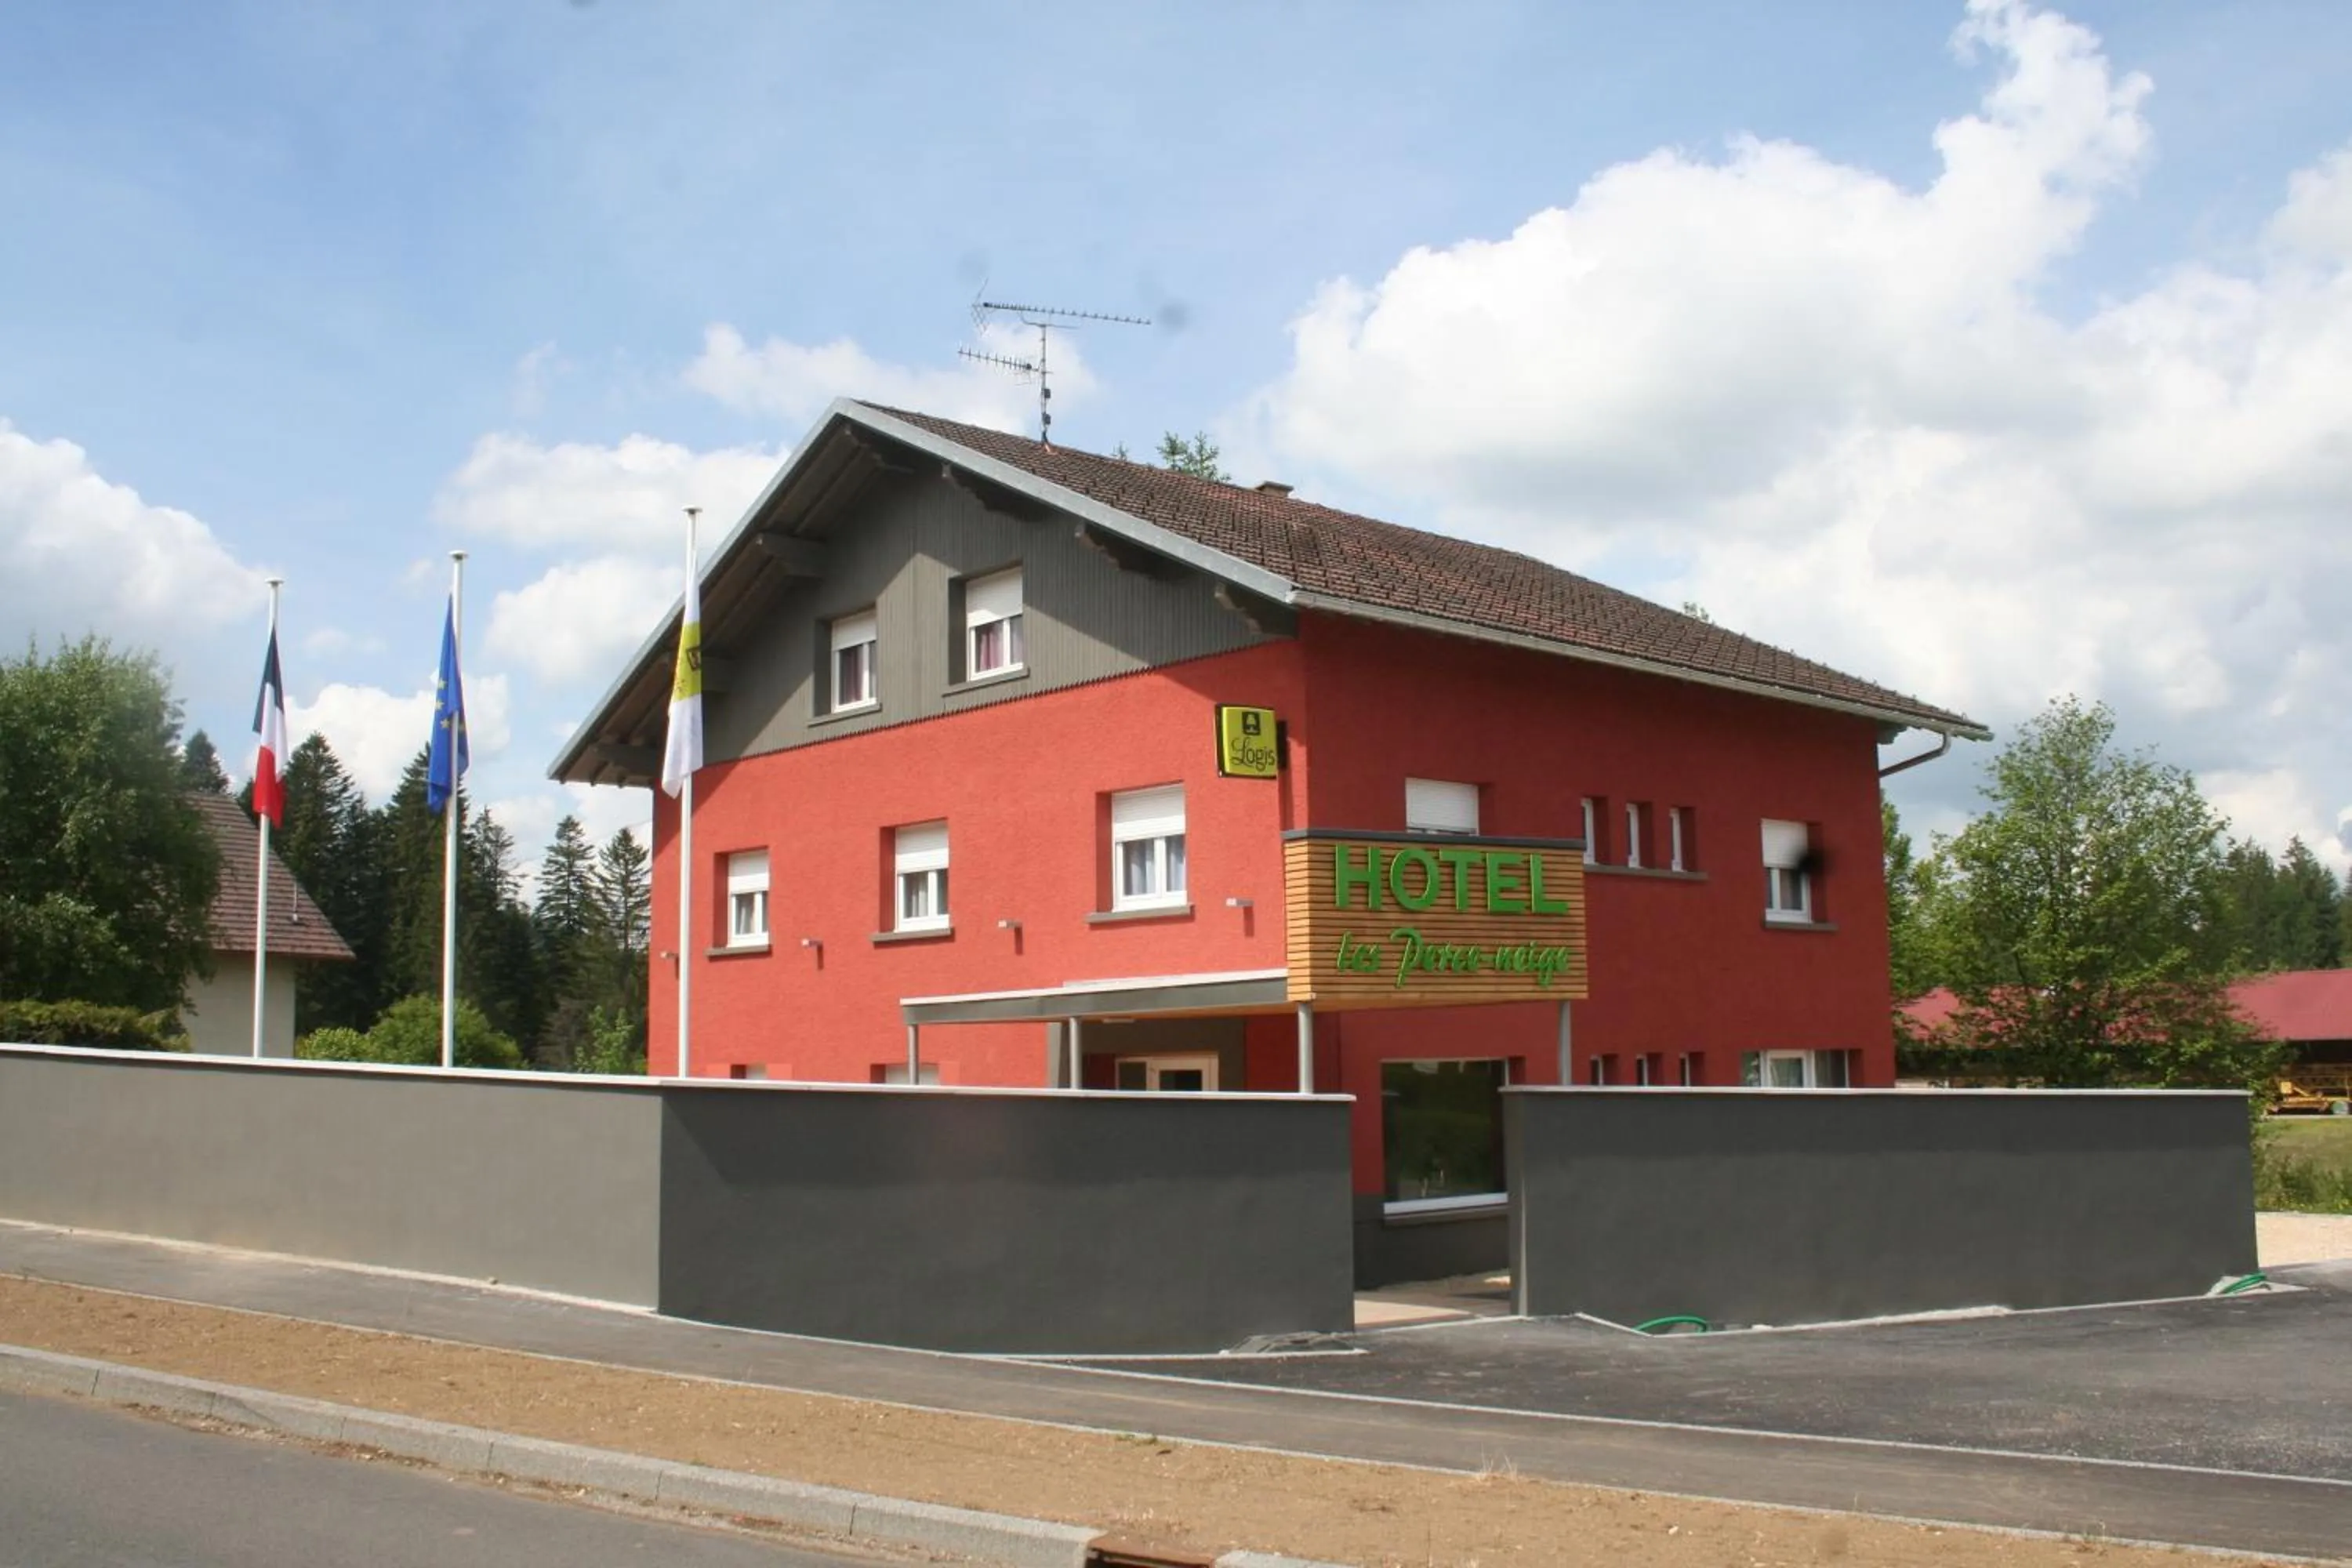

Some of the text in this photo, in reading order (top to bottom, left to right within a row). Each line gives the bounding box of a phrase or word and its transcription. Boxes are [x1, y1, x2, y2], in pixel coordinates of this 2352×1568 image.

[1230, 737, 1275, 772] Logis
[1334, 844, 1570, 915] HOTEL
[1389, 927, 1569, 989] Perce-neige
